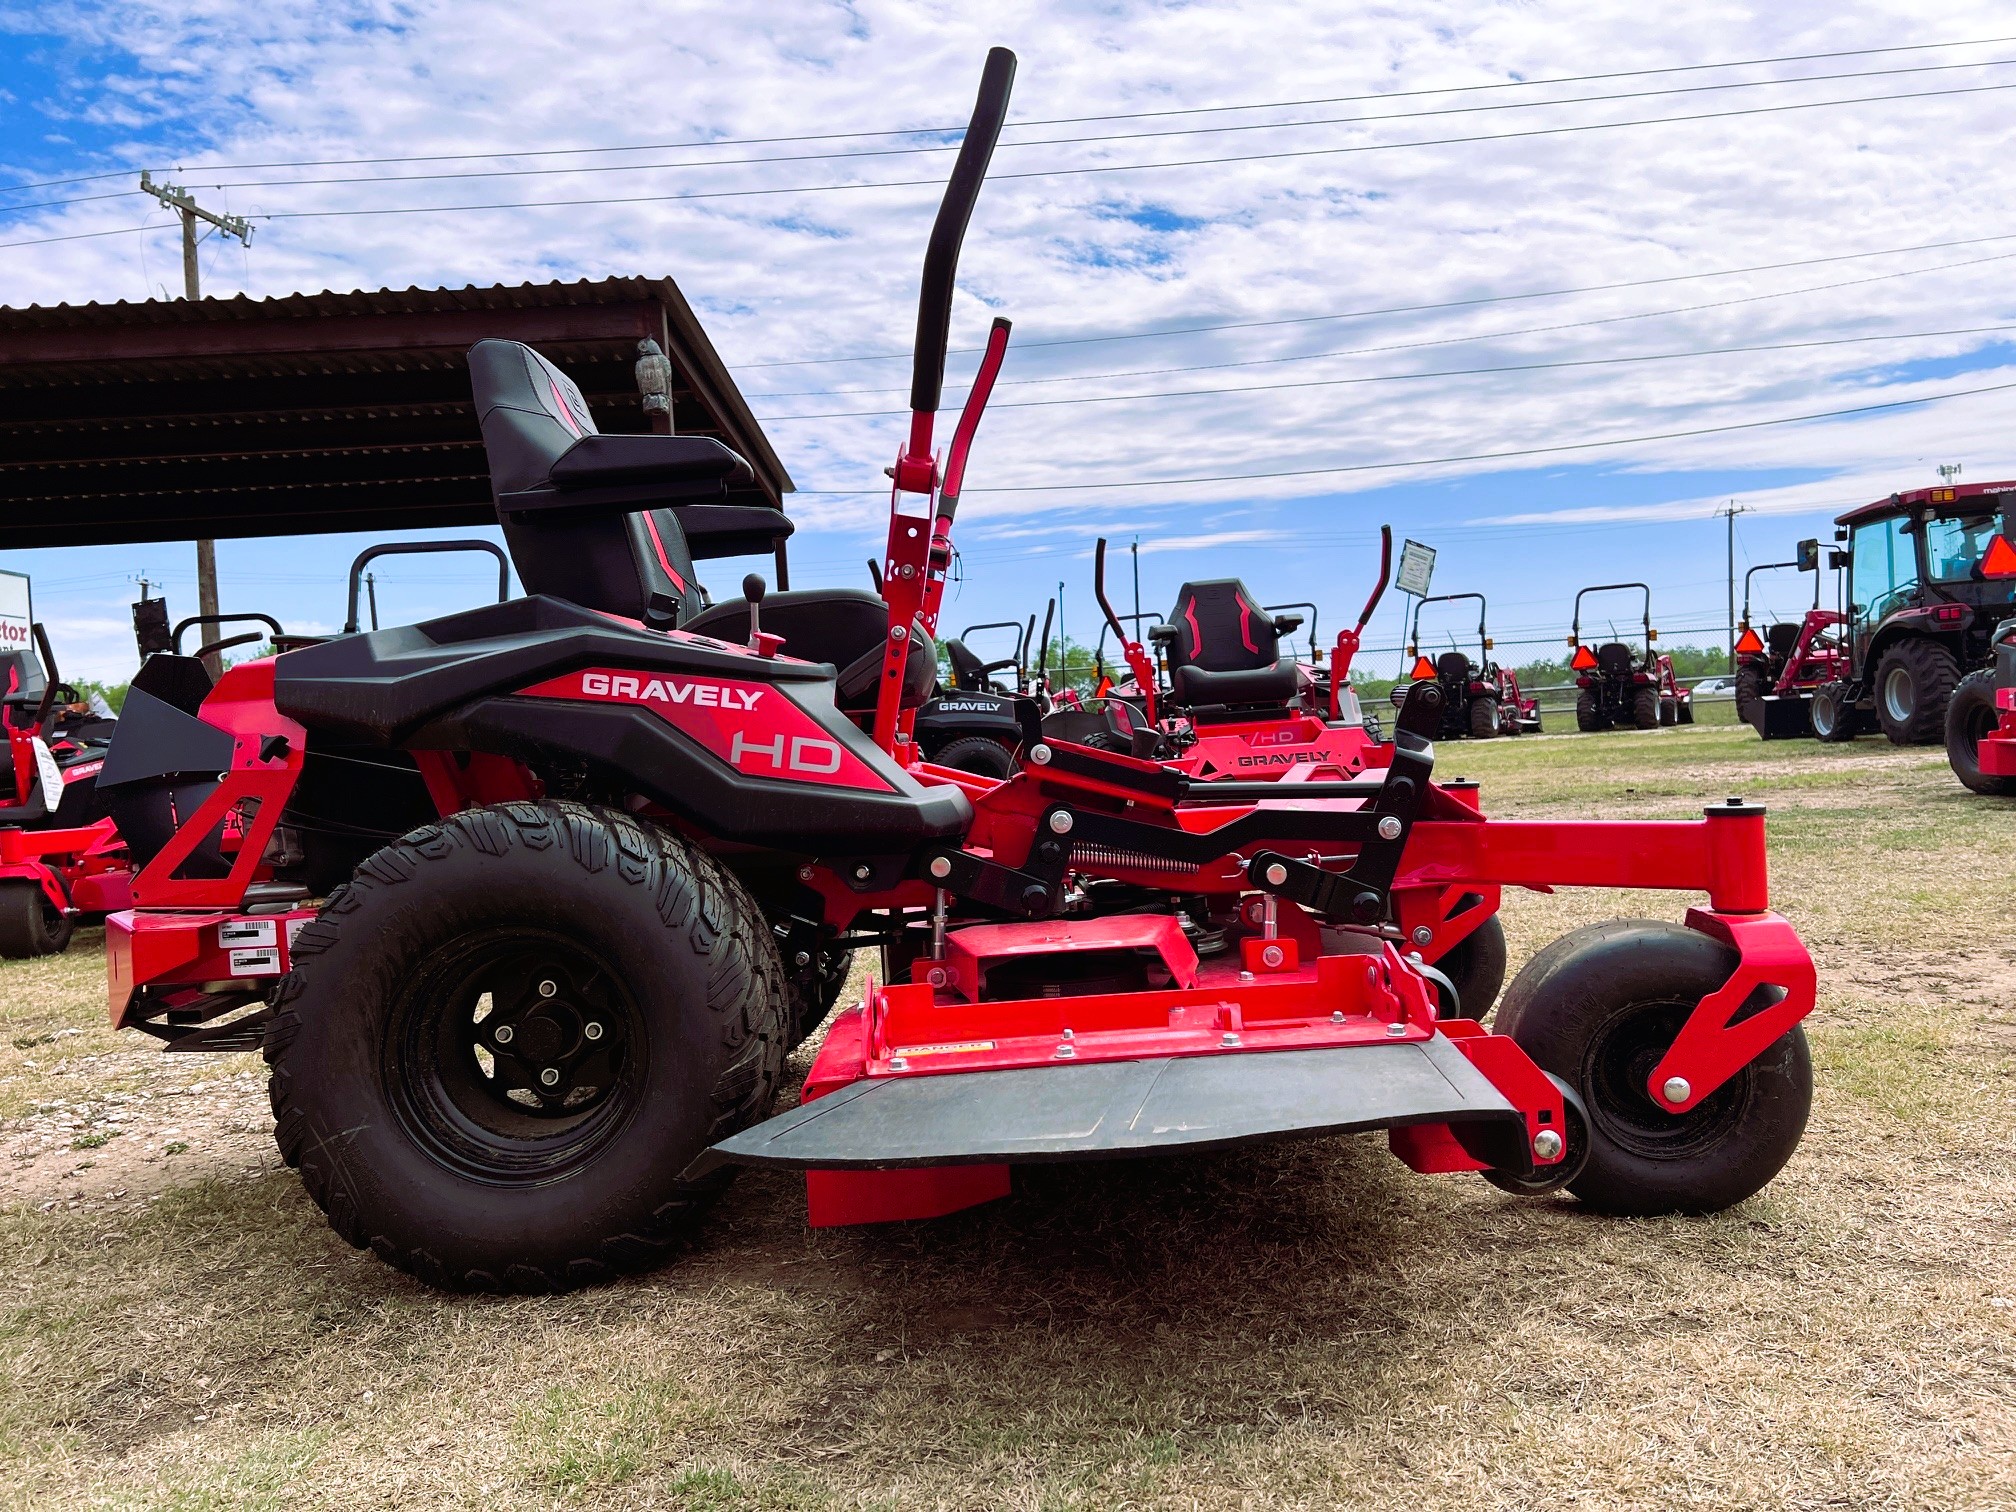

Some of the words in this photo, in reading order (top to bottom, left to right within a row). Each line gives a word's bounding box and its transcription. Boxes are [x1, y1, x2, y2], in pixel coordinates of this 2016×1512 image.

[582, 673, 764, 711] GRAVELY
[938, 702, 1001, 712] GRAVELY
[730, 730, 842, 774] HD
[1238, 751, 1331, 766] GRAVELY
